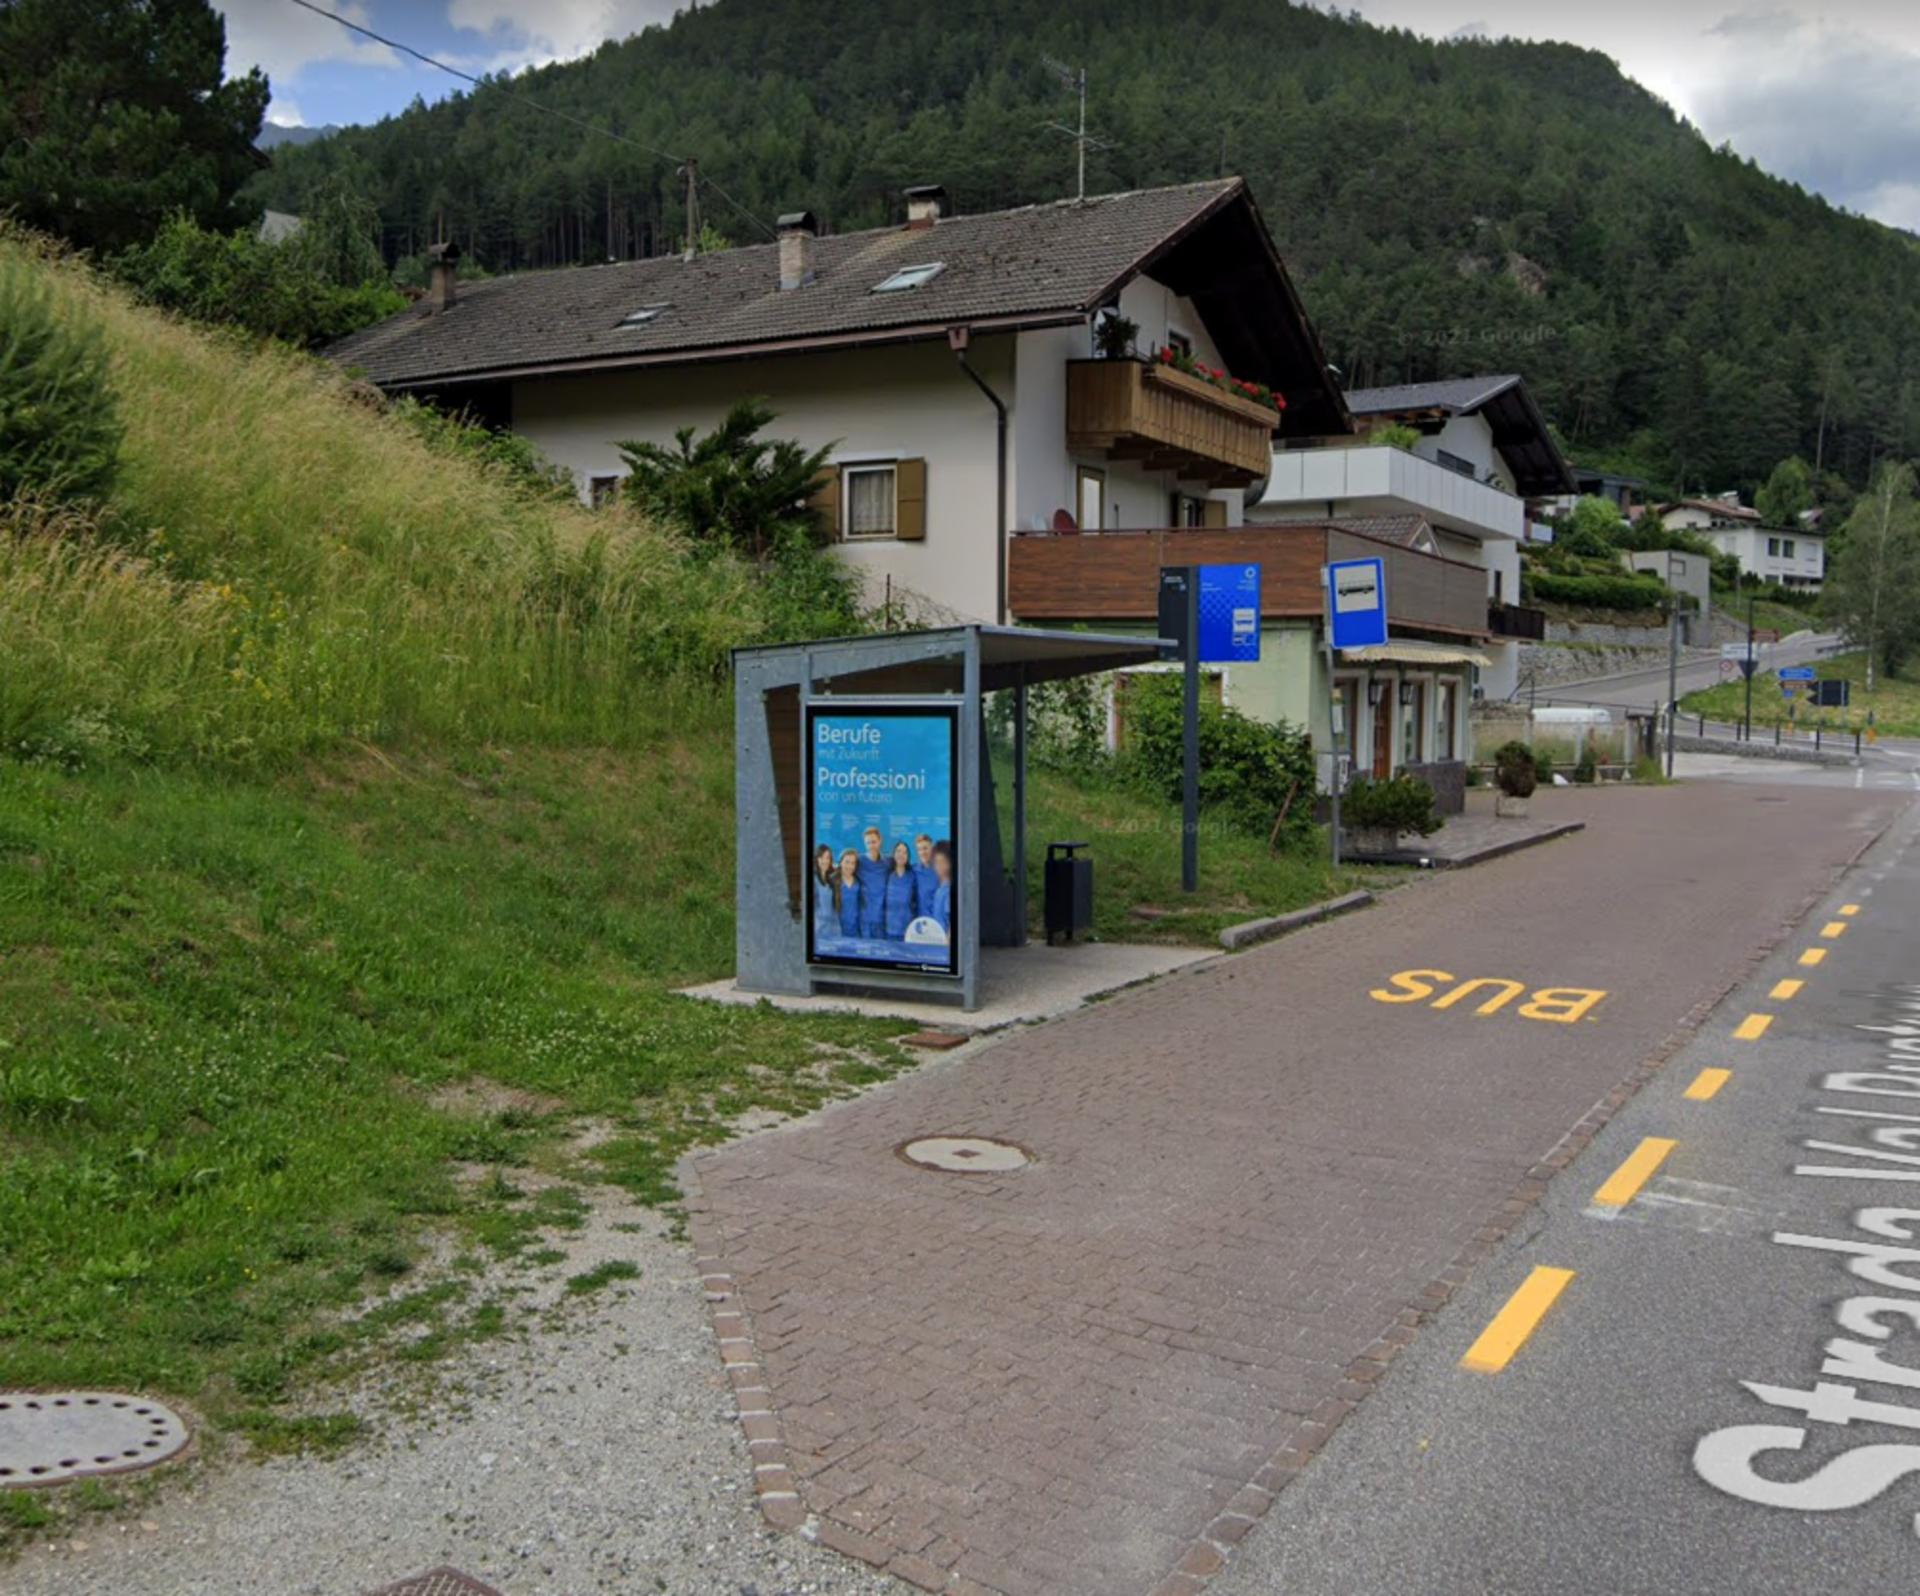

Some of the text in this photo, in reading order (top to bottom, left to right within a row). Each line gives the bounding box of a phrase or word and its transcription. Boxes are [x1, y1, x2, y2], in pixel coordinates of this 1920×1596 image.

[818, 723, 881, 744] Berufe
[818, 766, 925, 790] Professioni
[1369, 968, 1608, 1023] BUS
